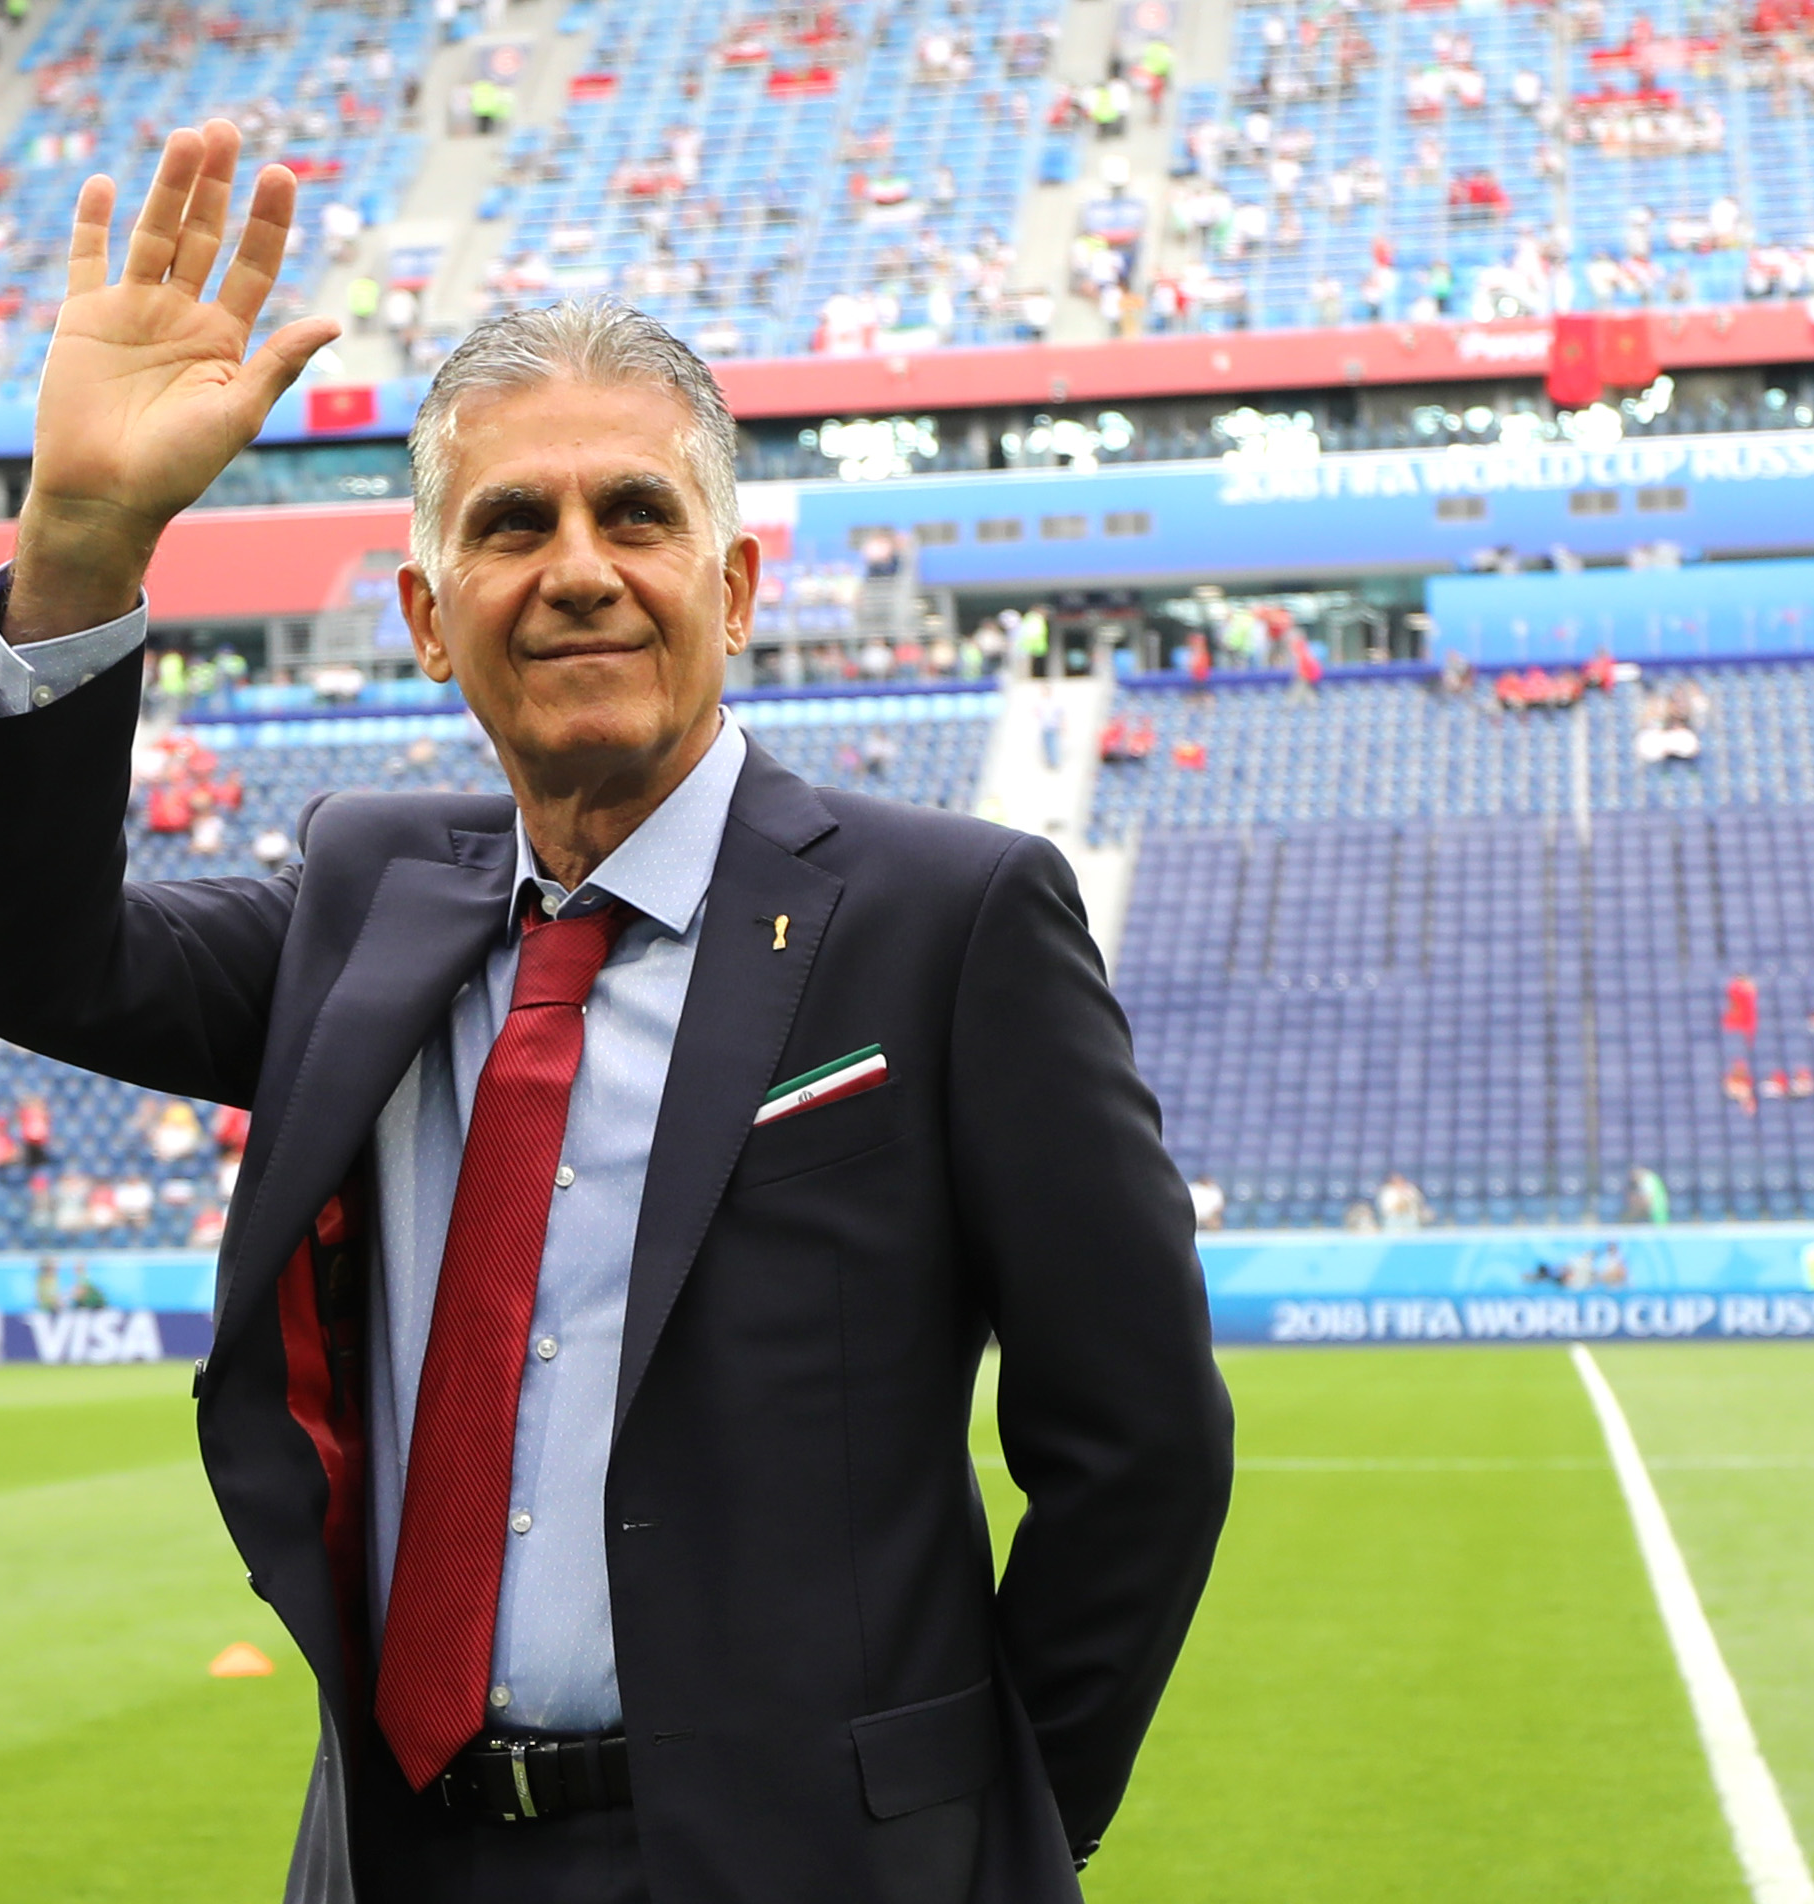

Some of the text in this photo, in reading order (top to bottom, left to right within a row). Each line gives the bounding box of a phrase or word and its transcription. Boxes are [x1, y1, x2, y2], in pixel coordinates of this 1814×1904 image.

[1324, 456, 1420, 498] FIFA
[1423, 450, 1584, 495] WORLD
[1590, 447, 1686, 488] CUP
[26, 1311, 162, 1364] VISA
[1271, 1299, 1368, 1340] 2018
[1370, 1297, 1463, 1339] FIFA
[1465, 1296, 1620, 1338] WORLD
[1623, 1295, 1716, 1337] CUP
